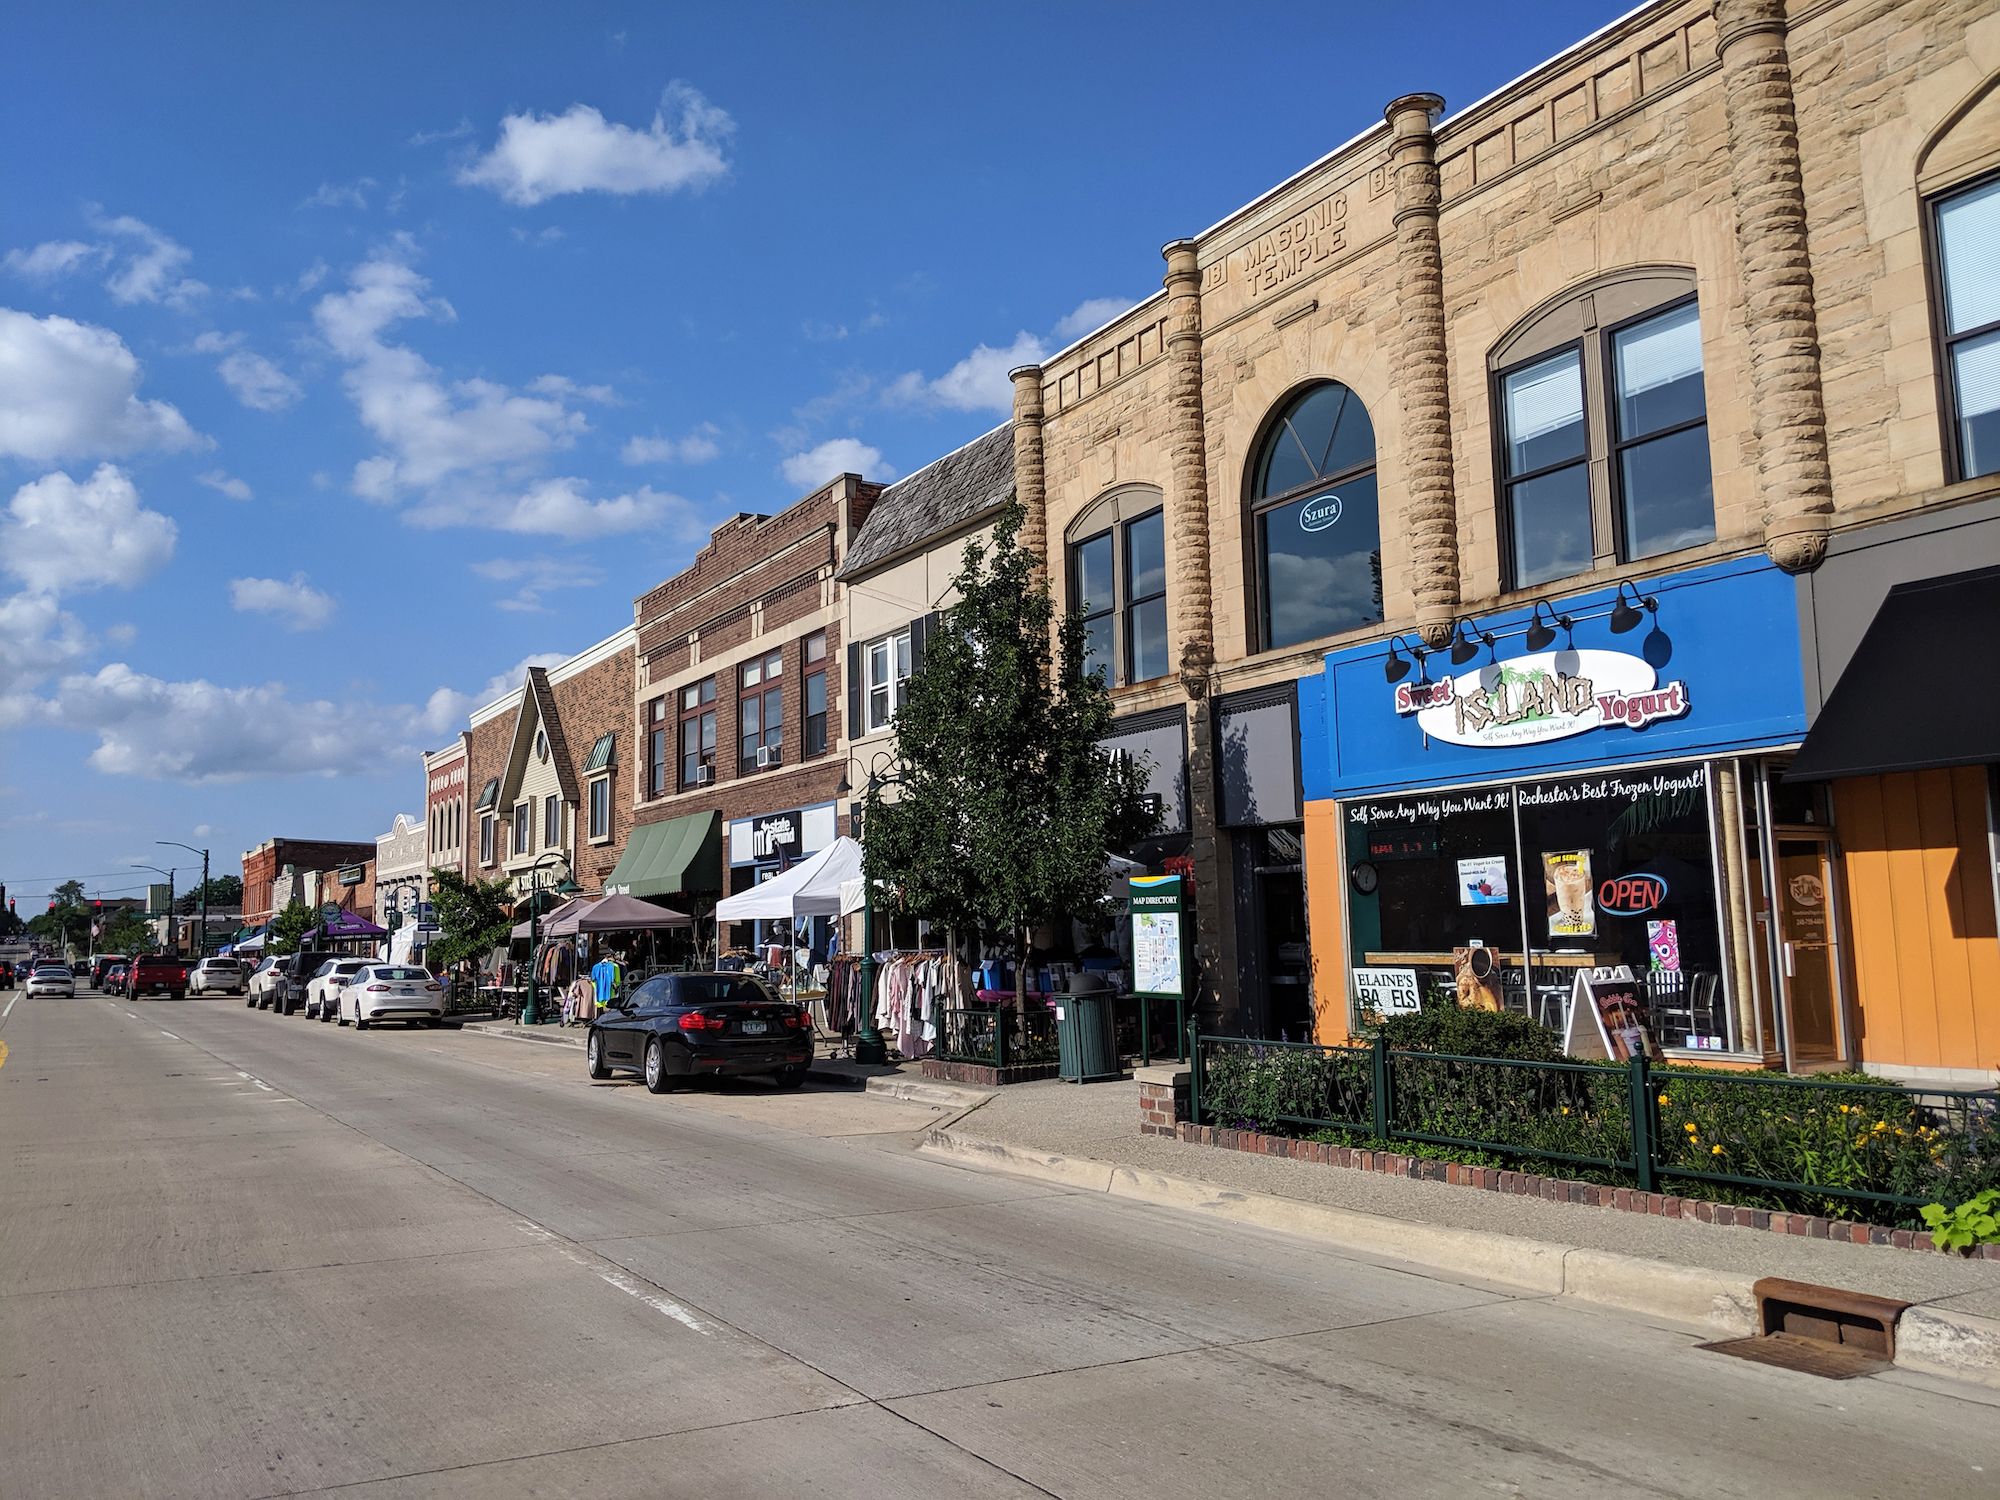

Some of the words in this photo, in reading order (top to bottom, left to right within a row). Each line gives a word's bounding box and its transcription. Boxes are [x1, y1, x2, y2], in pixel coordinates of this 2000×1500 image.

[1245, 191, 1348, 271] MASONIC
[1248, 221, 1347, 297] TEMPLE
[1304, 503, 1337, 523] Szura
[1397, 679, 1451, 709] Sweet
[1454, 671, 1594, 735] ISLAND
[1597, 685, 1681, 723] Yogurt
[1482, 731, 1494, 743] Self
[1510, 729, 1522, 740] Any
[1523, 728, 1536, 738] Way
[1536, 725, 1549, 736] You
[1519, 784, 1580, 806] Rochester's
[1581, 780, 1609, 800] Best
[1609, 779, 1652, 802] Frozen
[1653, 768, 1705, 798] Yogurt!
[1350, 804, 1368, 825] Self
[1370, 806, 1395, 820] Serve
[1394, 803, 1416, 823] Any
[1417, 801, 1440, 820] Way
[1441, 799, 1463, 818] You
[1463, 795, 1493, 812] Want
[1494, 792, 1510, 809] It!
[769, 816, 791, 834] state
[520, 873, 539, 890] STRET
[618, 883, 630, 895] Street
[1132, 896, 1145, 905] MAP
[1145, 895, 1178, 904] DIRECTORY
[1600, 879, 1661, 909] OPEN
[1357, 973, 1414, 988] ELAINE'S
[1359, 988, 1417, 1009] BAELS
